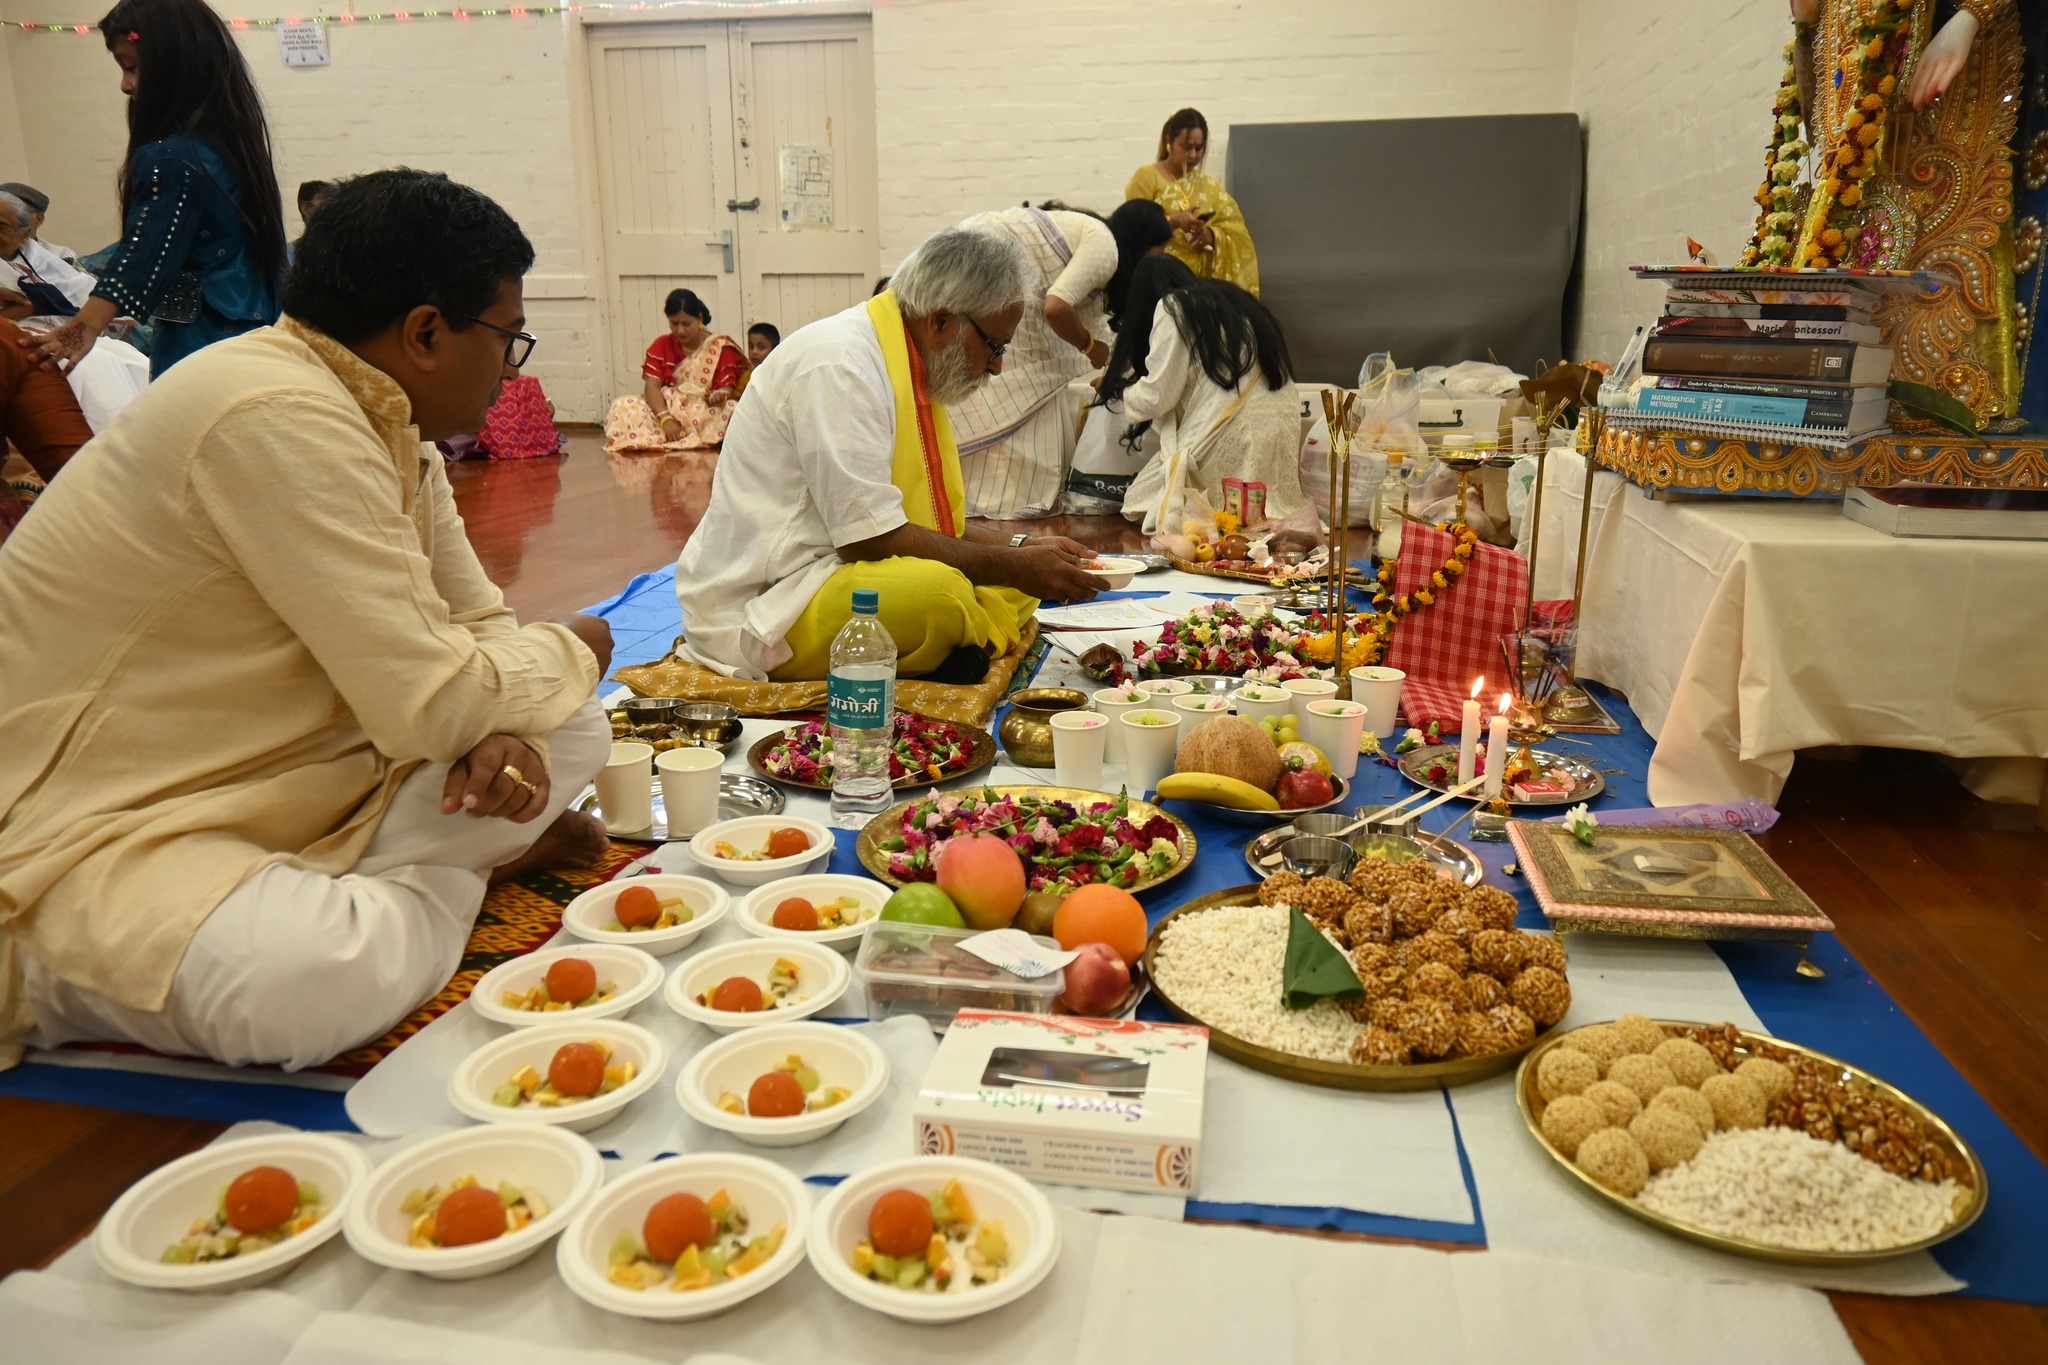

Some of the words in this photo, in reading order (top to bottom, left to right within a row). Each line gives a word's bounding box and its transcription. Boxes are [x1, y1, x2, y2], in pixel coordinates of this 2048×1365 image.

[1756, 324, 1784, 334] Maria
[1787, 325, 1842, 335] Montessori
[1723, 383, 1757, 391] Development
[1757, 385, 1779, 393] Projects
[1651, 394, 1697, 404] MATHEMATICAL
[1649, 400, 1678, 409] METHODS
[831, 693, 880, 713] गंगोत्री
[1056, 1096, 1143, 1123] Sweet
